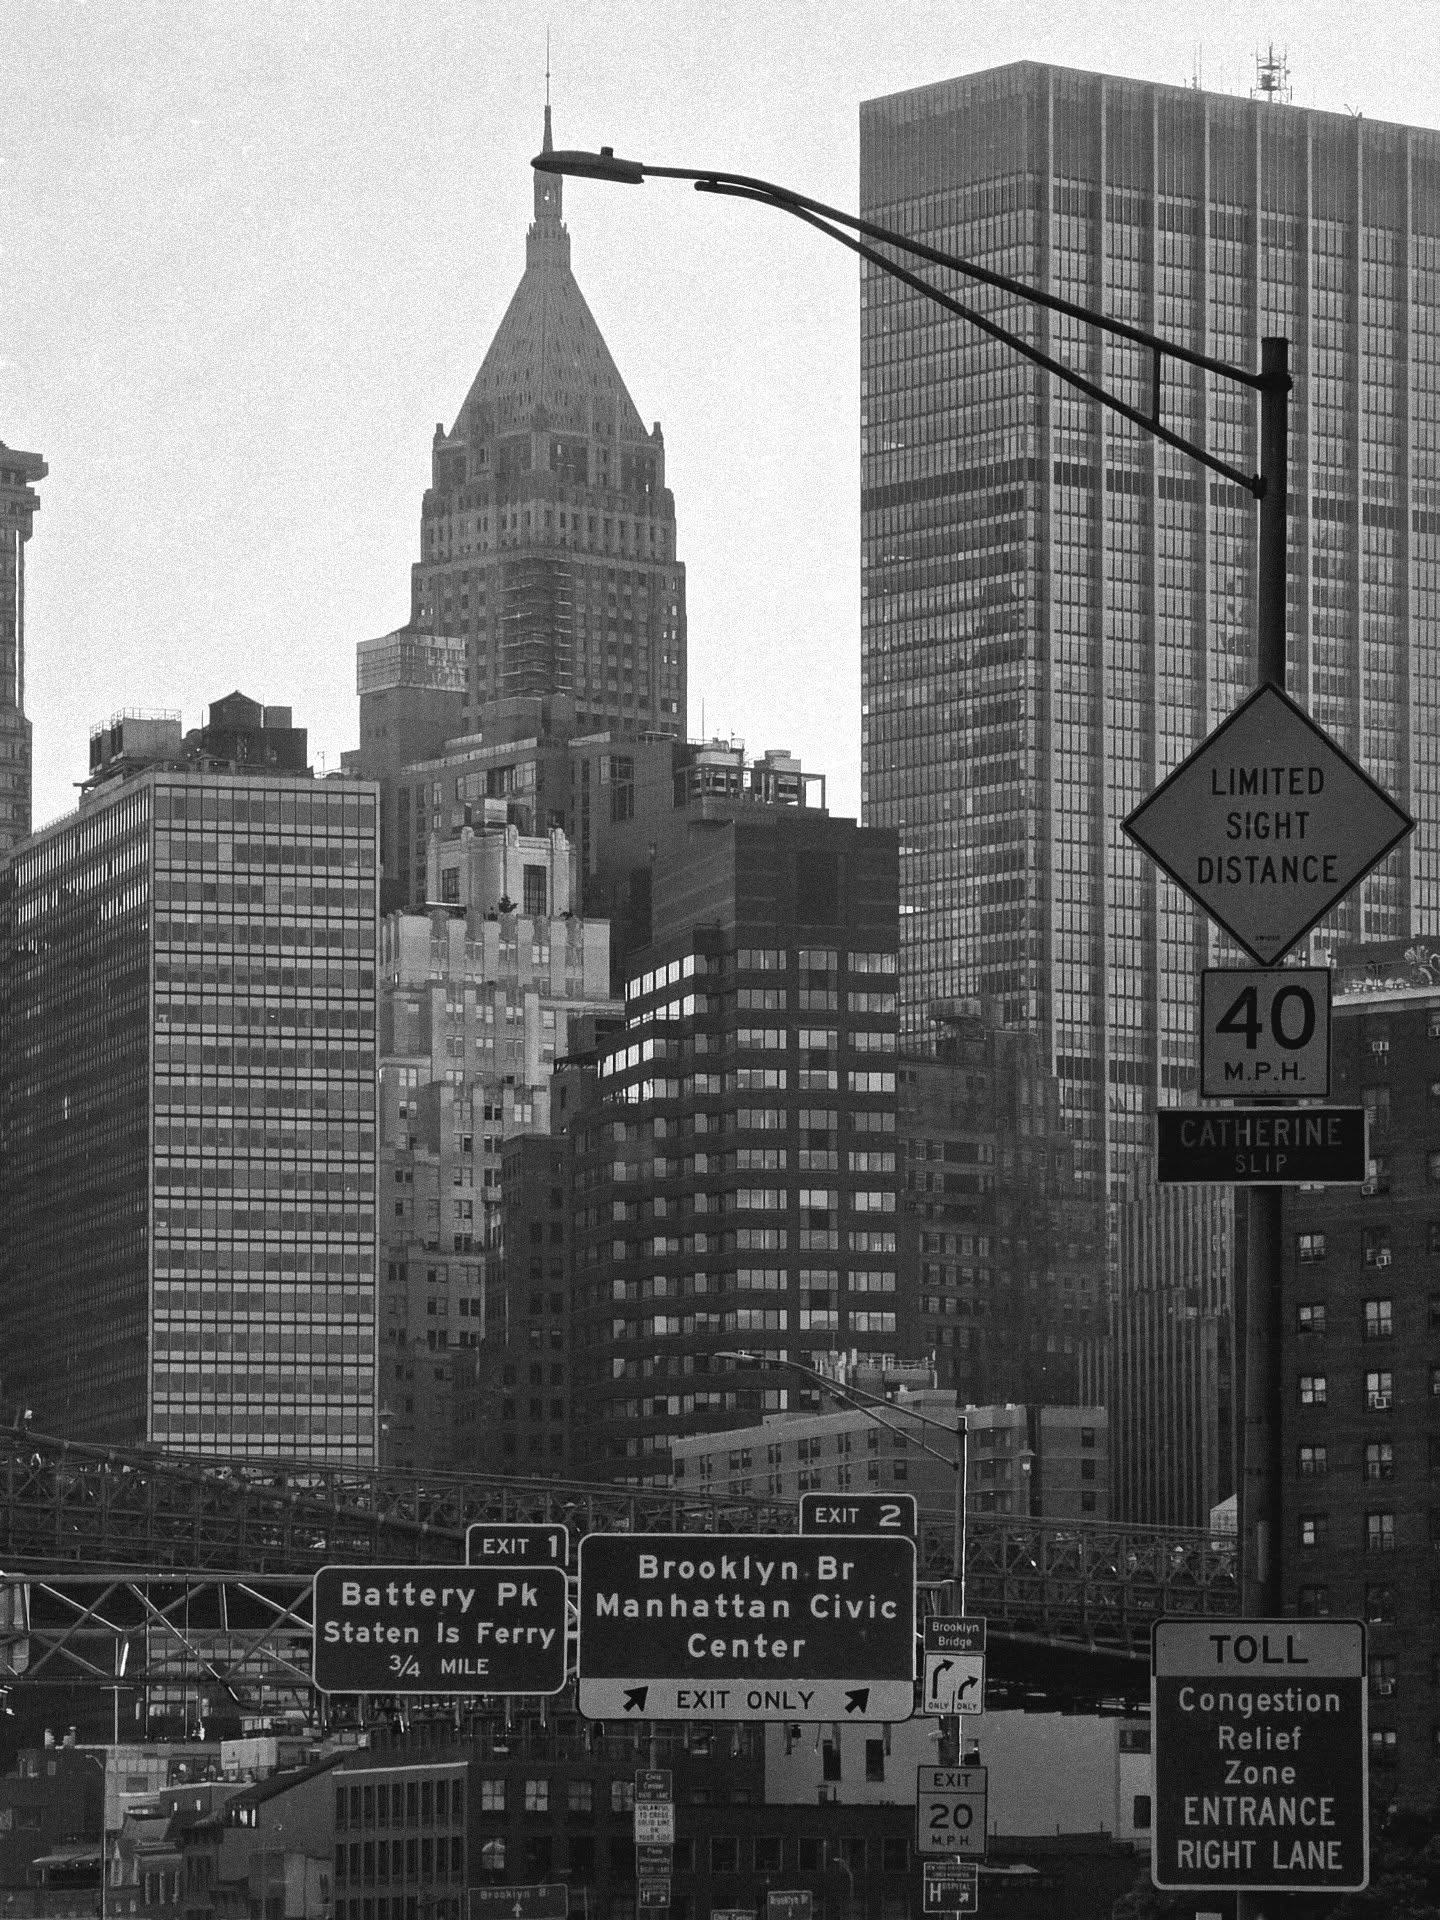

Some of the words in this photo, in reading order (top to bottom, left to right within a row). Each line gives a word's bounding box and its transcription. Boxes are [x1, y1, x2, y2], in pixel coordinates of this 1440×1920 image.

[1212, 768, 1325, 795] LIMITED
[1226, 812, 1310, 839] SIGHT
[1197, 855, 1339, 884] DISTANCE
[1215, 985, 1316, 1050] 40
[1224, 1061, 1306, 1081] M.P.H.
[1180, 1117, 1343, 1148] CATHERINE
[1235, 1154, 1288, 1173] SLIP
[815, 1507, 859, 1523] EXIT
[879, 1505, 901, 1527] 2
[483, 1538, 530, 1554] EXIT
[548, 1535, 558, 1557] 1
[638, 1555, 798, 1586] Brooklyn
[817, 1556, 854, 1580] Br
[342, 1582, 475, 1613] Battery
[498, 1582, 538, 1606] Pk
[596, 1593, 790, 1618] Manhattan
[810, 1594, 897, 1618] Civic
[324, 1621, 419, 1644] Staten
[437, 1622, 460, 1643] Is
[477, 1622, 556, 1650] Ferry
[932, 1621, 980, 1634] Brooklyn
[687, 1633, 806, 1658] Center
[938, 1636, 972, 1649] Bridge
[1209, 1635, 1309, 1664] TOLL
[441, 1658, 489, 1675] MILE
[677, 1690, 731, 1709] EXIT
[747, 1691, 815, 1710] ONLY
[928, 1701, 949, 1710] ONLY
[956, 1703, 977, 1711] ONLY
[1179, 1686, 1340, 1719] Congestion
[1218, 1726, 1301, 1750] Relief
[933, 1773, 971, 1787] EXIT
[1224, 1760, 1297, 1784] Zone
[929, 1803, 973, 1830] 20
[1184, 1797, 1336, 1826] ENTRANCE
[1177, 1840, 1257, 1869] RIGHT
[1272, 1840, 1343, 1869] LANE
[481, 1890, 531, 1900] Brooklyn
